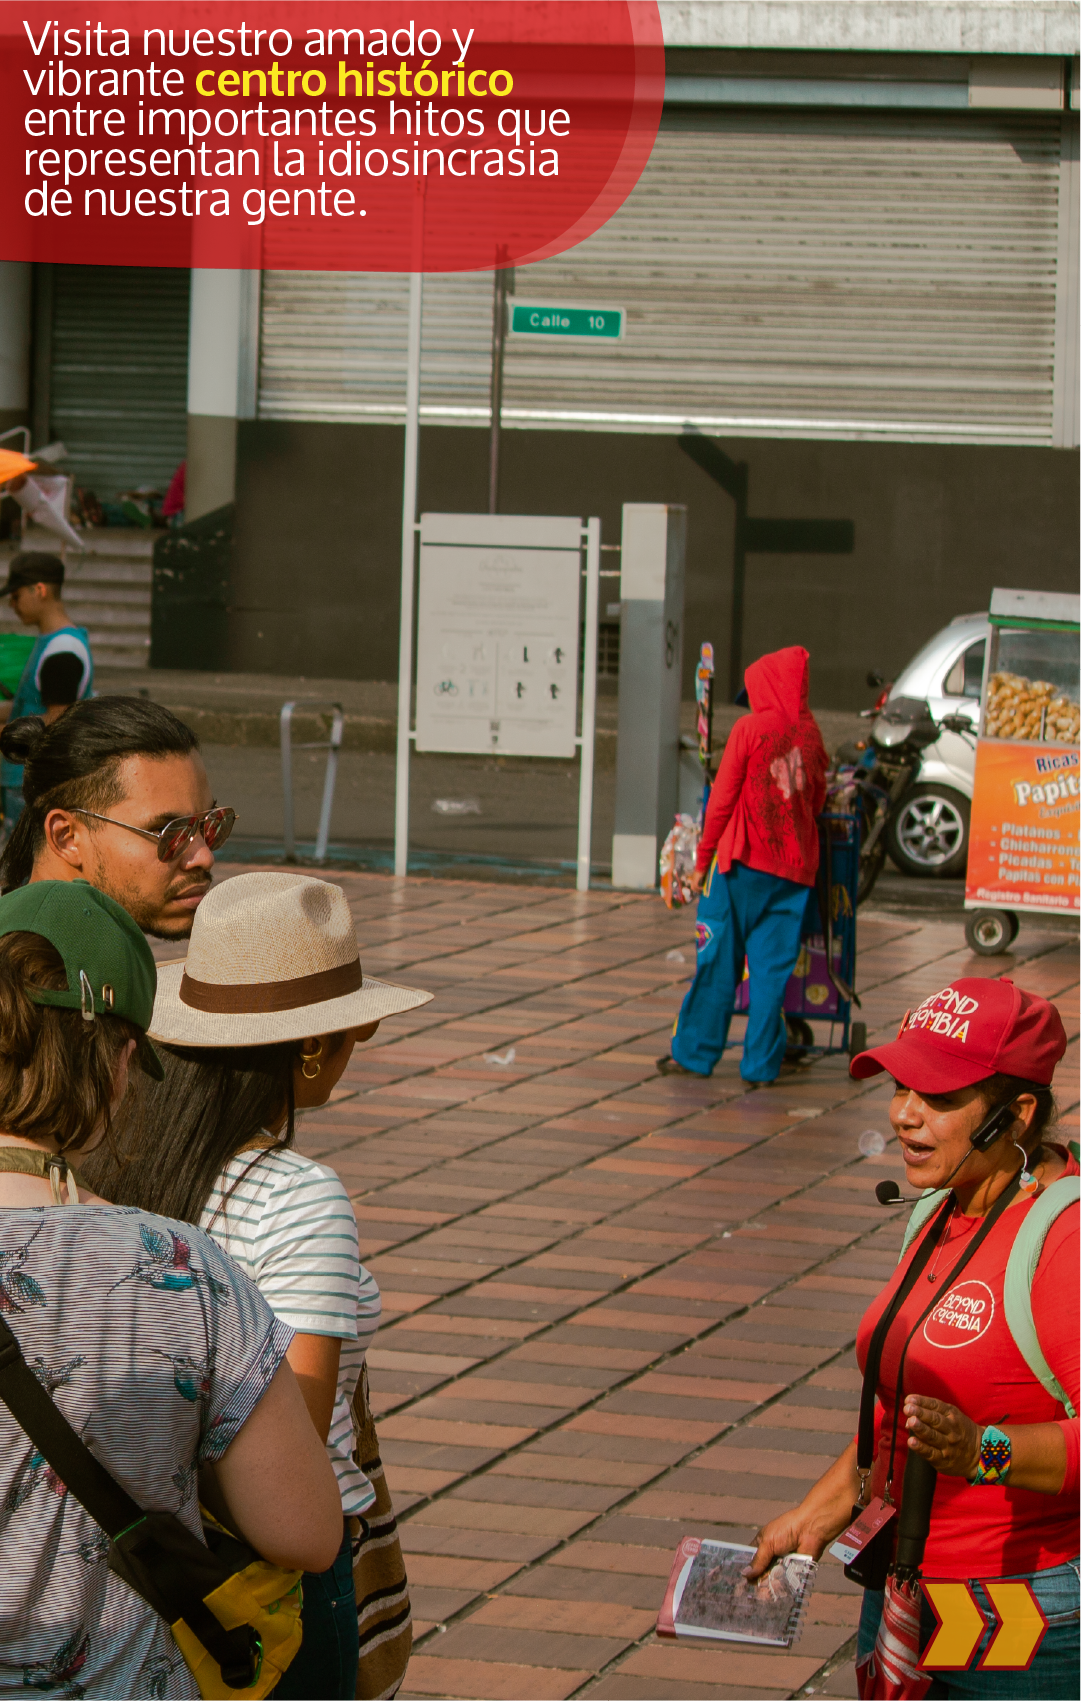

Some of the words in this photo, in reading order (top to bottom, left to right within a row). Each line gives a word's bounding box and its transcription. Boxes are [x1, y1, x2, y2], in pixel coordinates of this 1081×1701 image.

[530, 313, 570, 327] Calle
[589, 316, 605, 329] 10
[1035, 753, 1079, 773] Ricas
[1013, 773, 1081, 807] Papit
[999, 852, 1053, 870] Picadas
[998, 866, 1041, 883] Papitas
[1043, 873, 1065, 886] con
[943, 1293, 986, 1315] BEYOND
[932, 1307, 981, 1333] COLOMBIA
